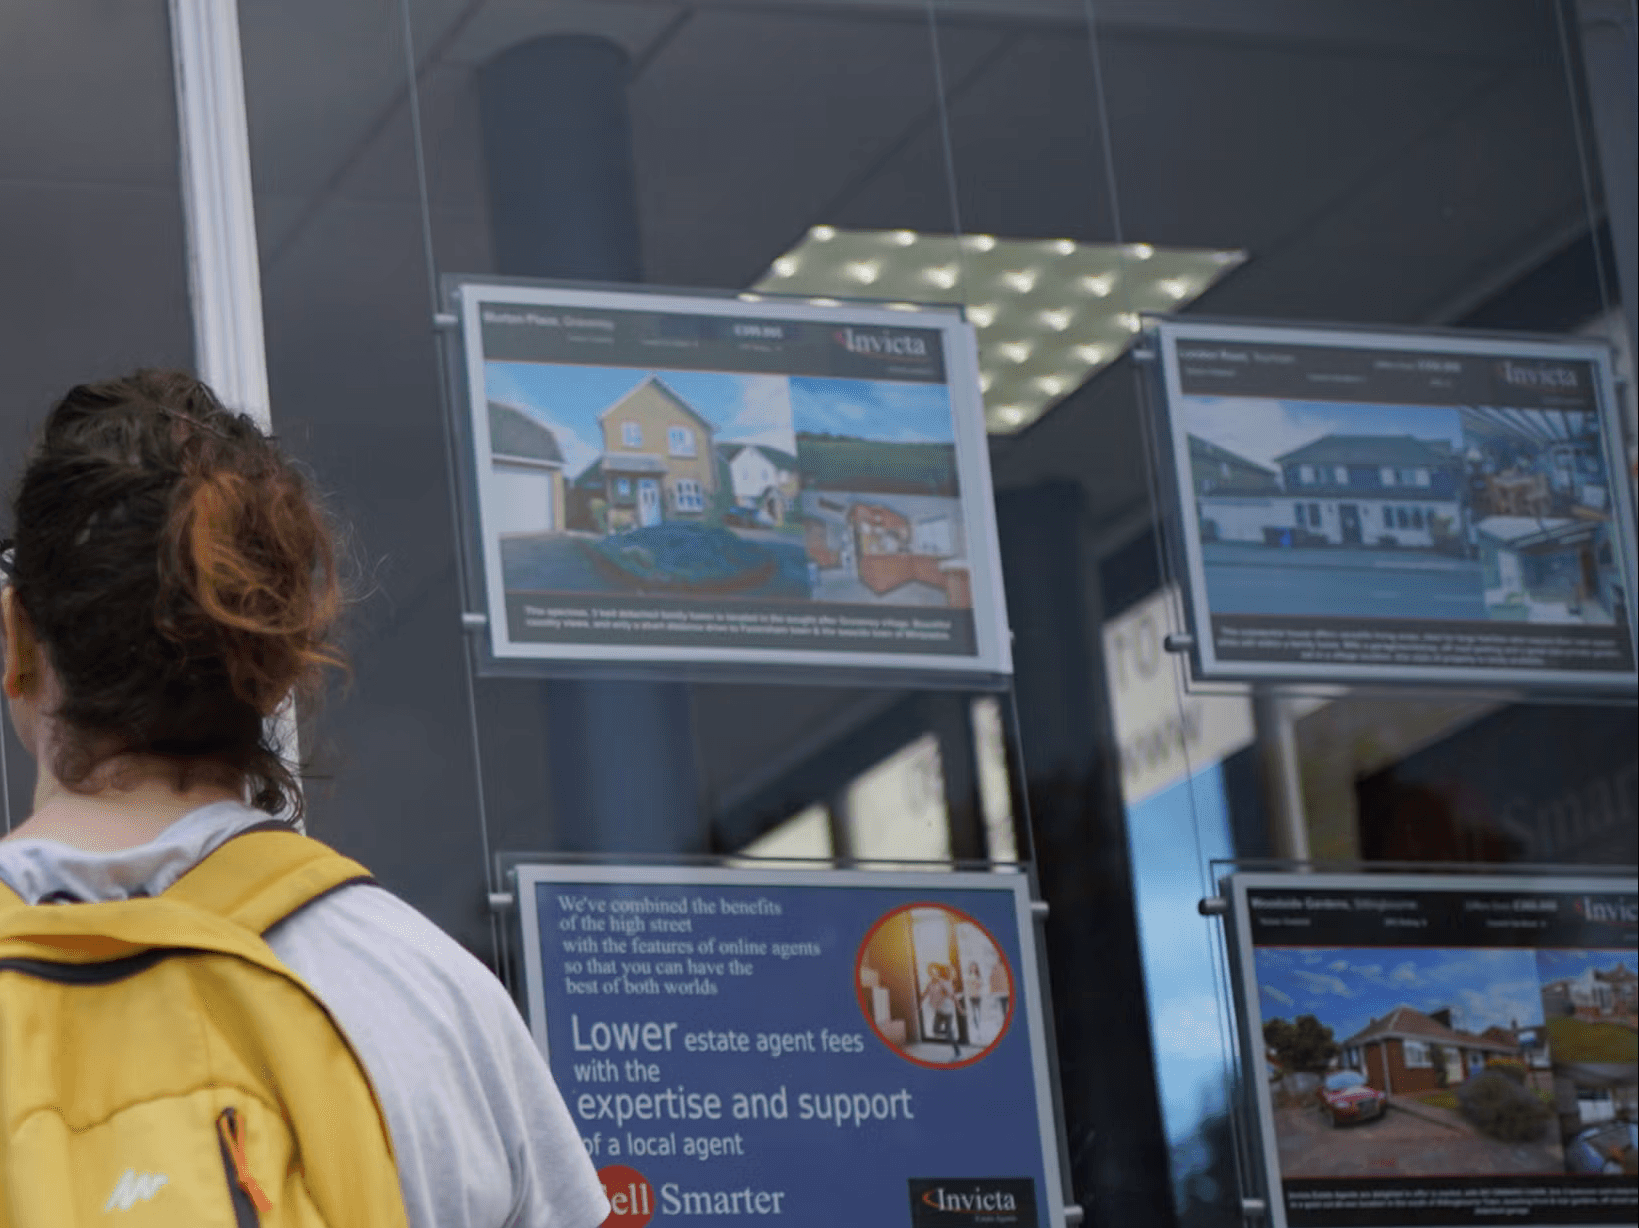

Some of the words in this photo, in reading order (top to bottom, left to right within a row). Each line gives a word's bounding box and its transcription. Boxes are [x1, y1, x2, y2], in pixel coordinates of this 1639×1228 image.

[844, 328, 927, 356] Invicta
[1504, 360, 1579, 387] Invicta
[557, 895, 606, 912] We've
[609, 896, 688, 913] combined
[691, 897, 716, 914] the
[720, 897, 781, 915] benefits
[1584, 896, 1638, 921] Invic
[559, 915, 578, 931] of
[580, 915, 605, 931] the
[609, 915, 645, 936] high
[649, 918, 692, 932] street
[562, 936, 598, 953] with
[601, 937, 627, 953] the
[631, 937, 694, 954] features
[696, 938, 716, 954] of
[718, 938, 767, 955] online
[771, 941, 821, 960] agents
[564, 961, 583, 974] so
[586, 957, 617, 974] that
[621, 961, 651, 979] you
[655, 961, 683, 975] can
[686, 958, 724, 975] have
[727, 959, 753, 975] the
[564, 976, 598, 994] best
[601, 976, 624, 994] of
[623, 977, 660, 994] both
[663, 978, 718, 995] worlds
[571, 1013, 678, 1052] Lower
[684, 1030, 750, 1052] estate
[756, 1030, 815, 1057] agent
[820, 1028, 864, 1052] fees
[573, 1058, 619, 1082] with
[624, 1058, 660, 1082] the
[577, 1085, 722, 1127] expertise
[732, 1085, 788, 1119] and
[798, 1088, 914, 1127] support
[581, 1132, 600, 1157] of
[608, 1137, 621, 1156] a
[626, 1132, 676, 1156] local
[683, 1133, 744, 1161] agent
[602, 1183, 650, 1216] ell
[661, 1182, 785, 1216] Smarter
[938, 1186, 1018, 1213] Invicta
